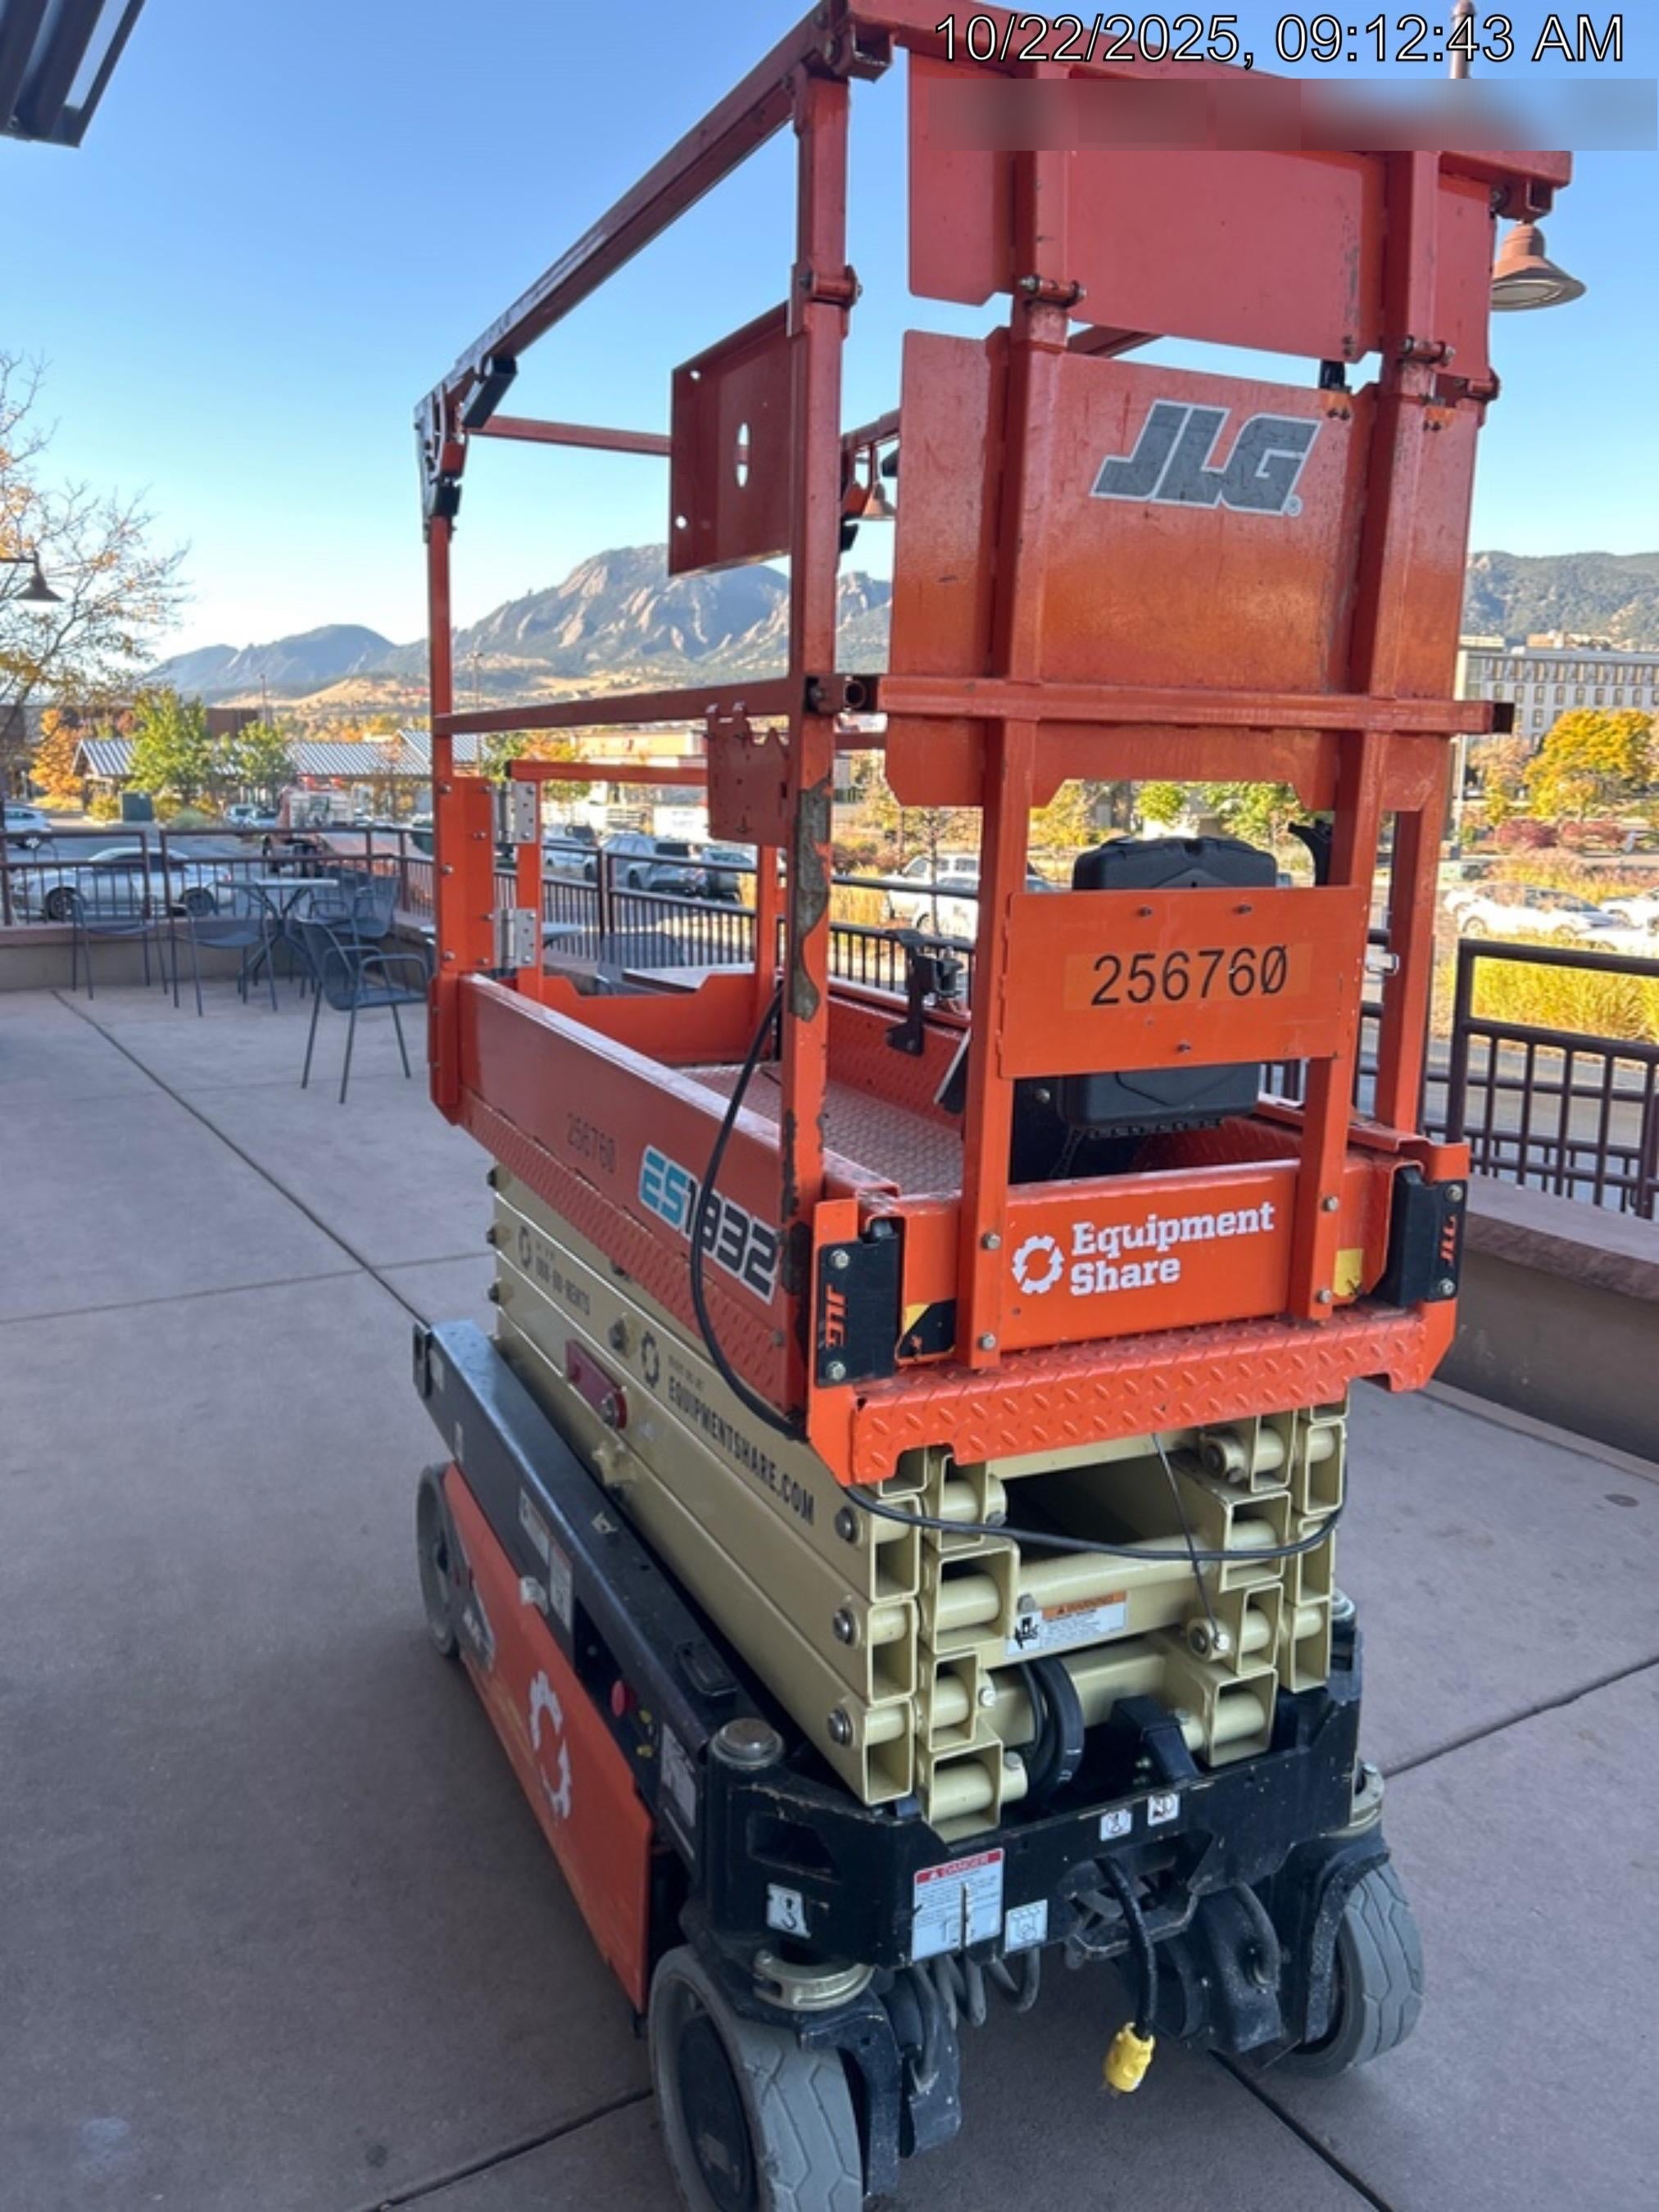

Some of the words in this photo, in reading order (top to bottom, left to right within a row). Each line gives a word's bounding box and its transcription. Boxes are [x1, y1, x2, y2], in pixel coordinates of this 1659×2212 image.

[1090, 399, 1321, 516] JLG
[1090, 944, 1288, 1006] 256760
[1071, 1201, 1275, 1258] Equipment
[1070, 1257, 1181, 1296] Share
[825, 1284, 846, 1350] JLG
